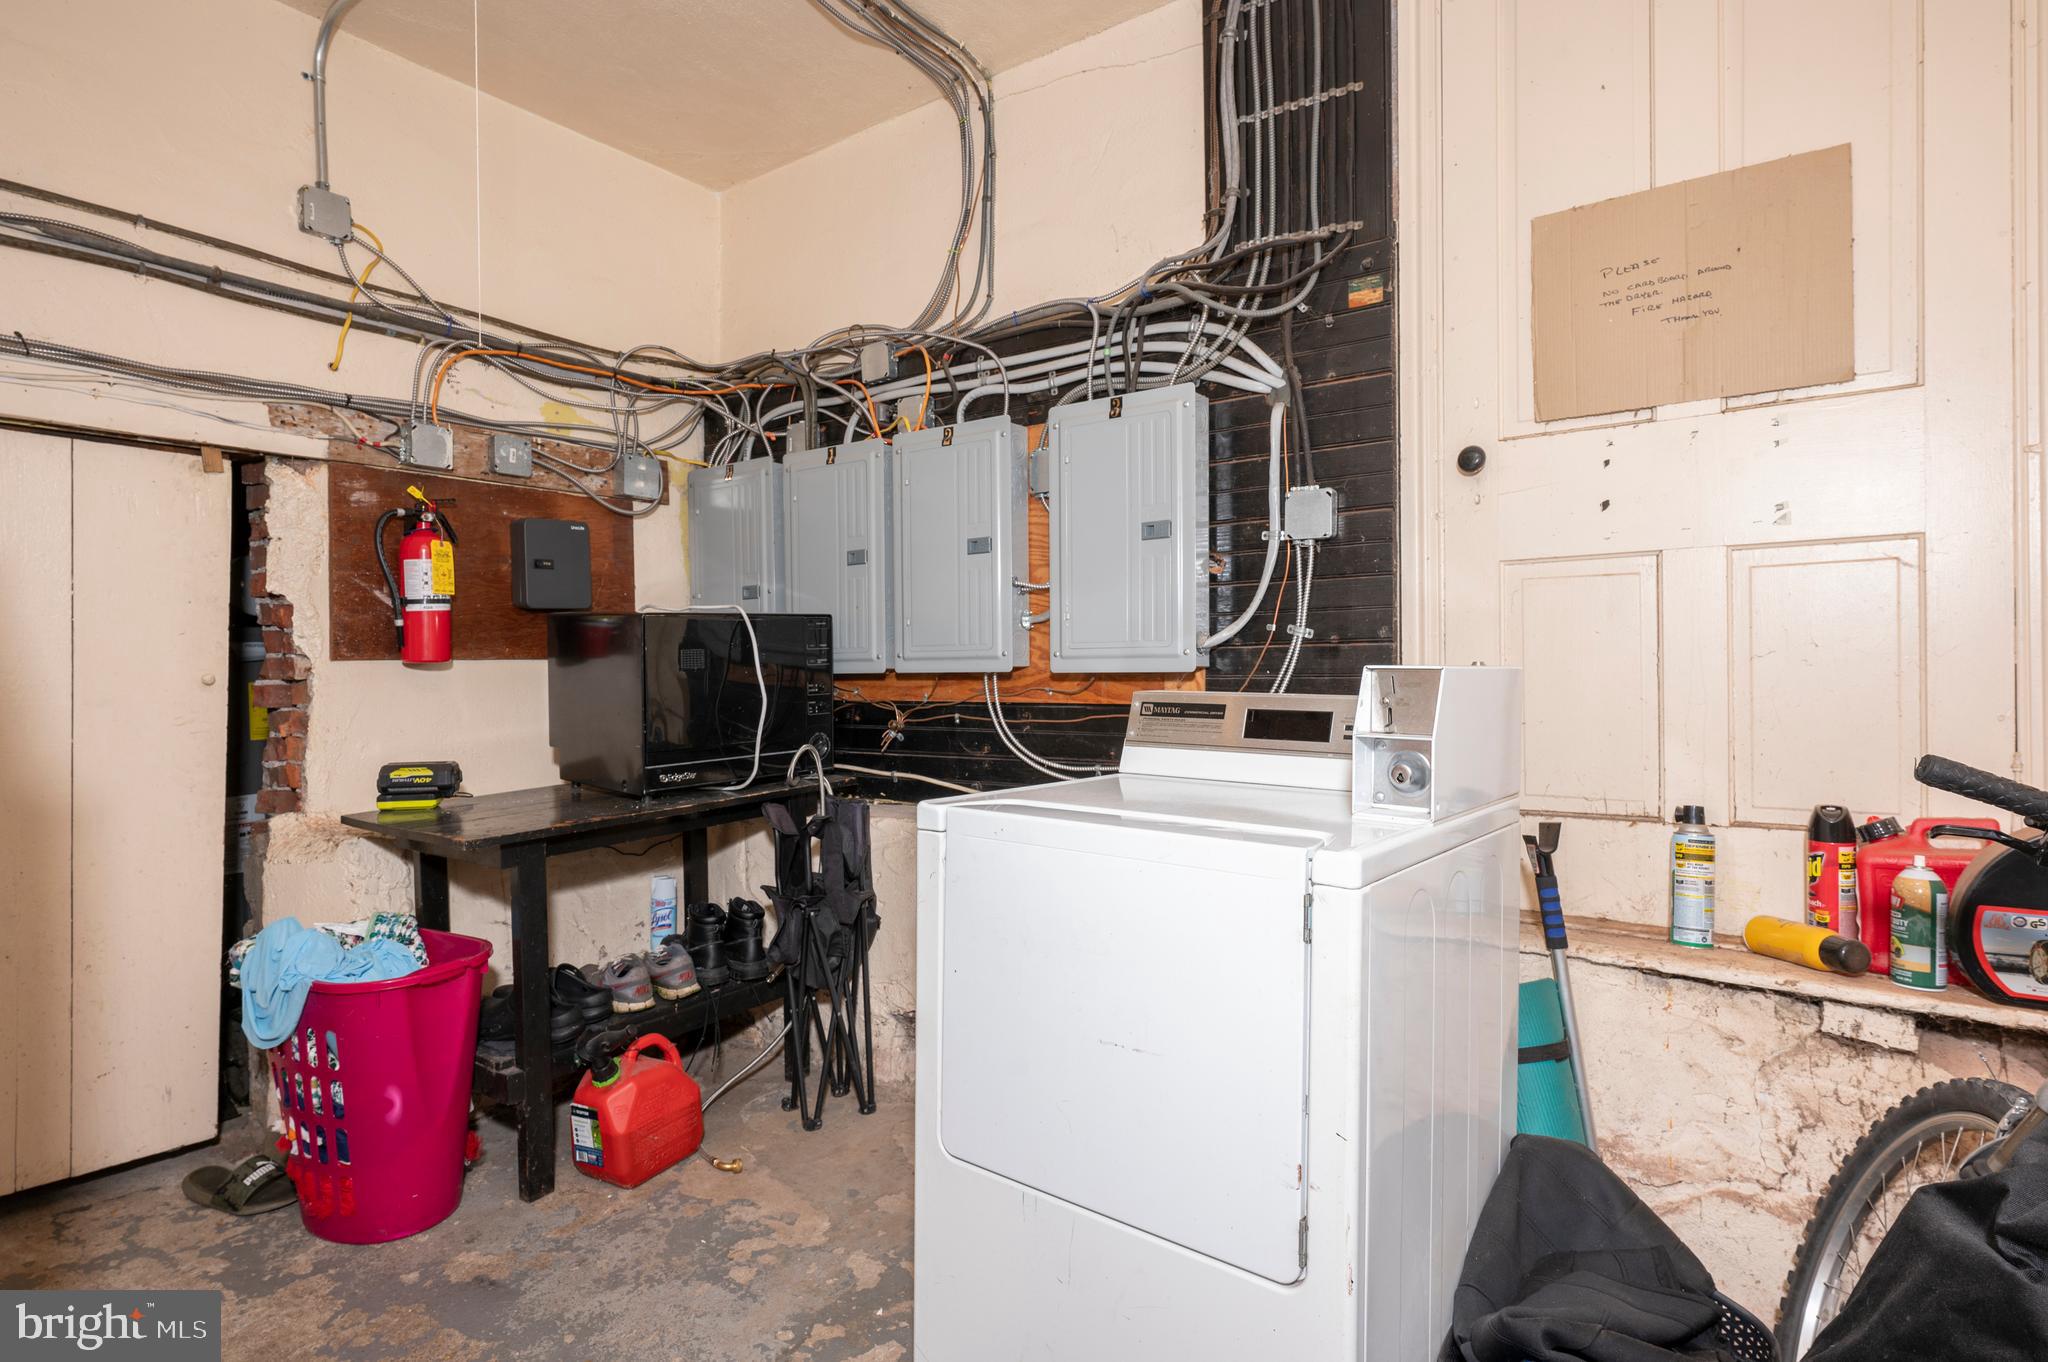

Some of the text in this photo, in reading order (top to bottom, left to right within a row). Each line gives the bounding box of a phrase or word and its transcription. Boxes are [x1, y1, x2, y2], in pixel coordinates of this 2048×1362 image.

[1600, 257, 1660, 279] PLEASE
[1602, 289, 1619, 298] NO
[1599, 299, 1622, 307] THE
[1631, 303, 1662, 316] FIRE
[1110, 398, 1121, 417] 3
[943, 427, 953, 446] 2
[827, 447, 835, 465] 1
[1153, 706, 1181, 714] MAYTAG
